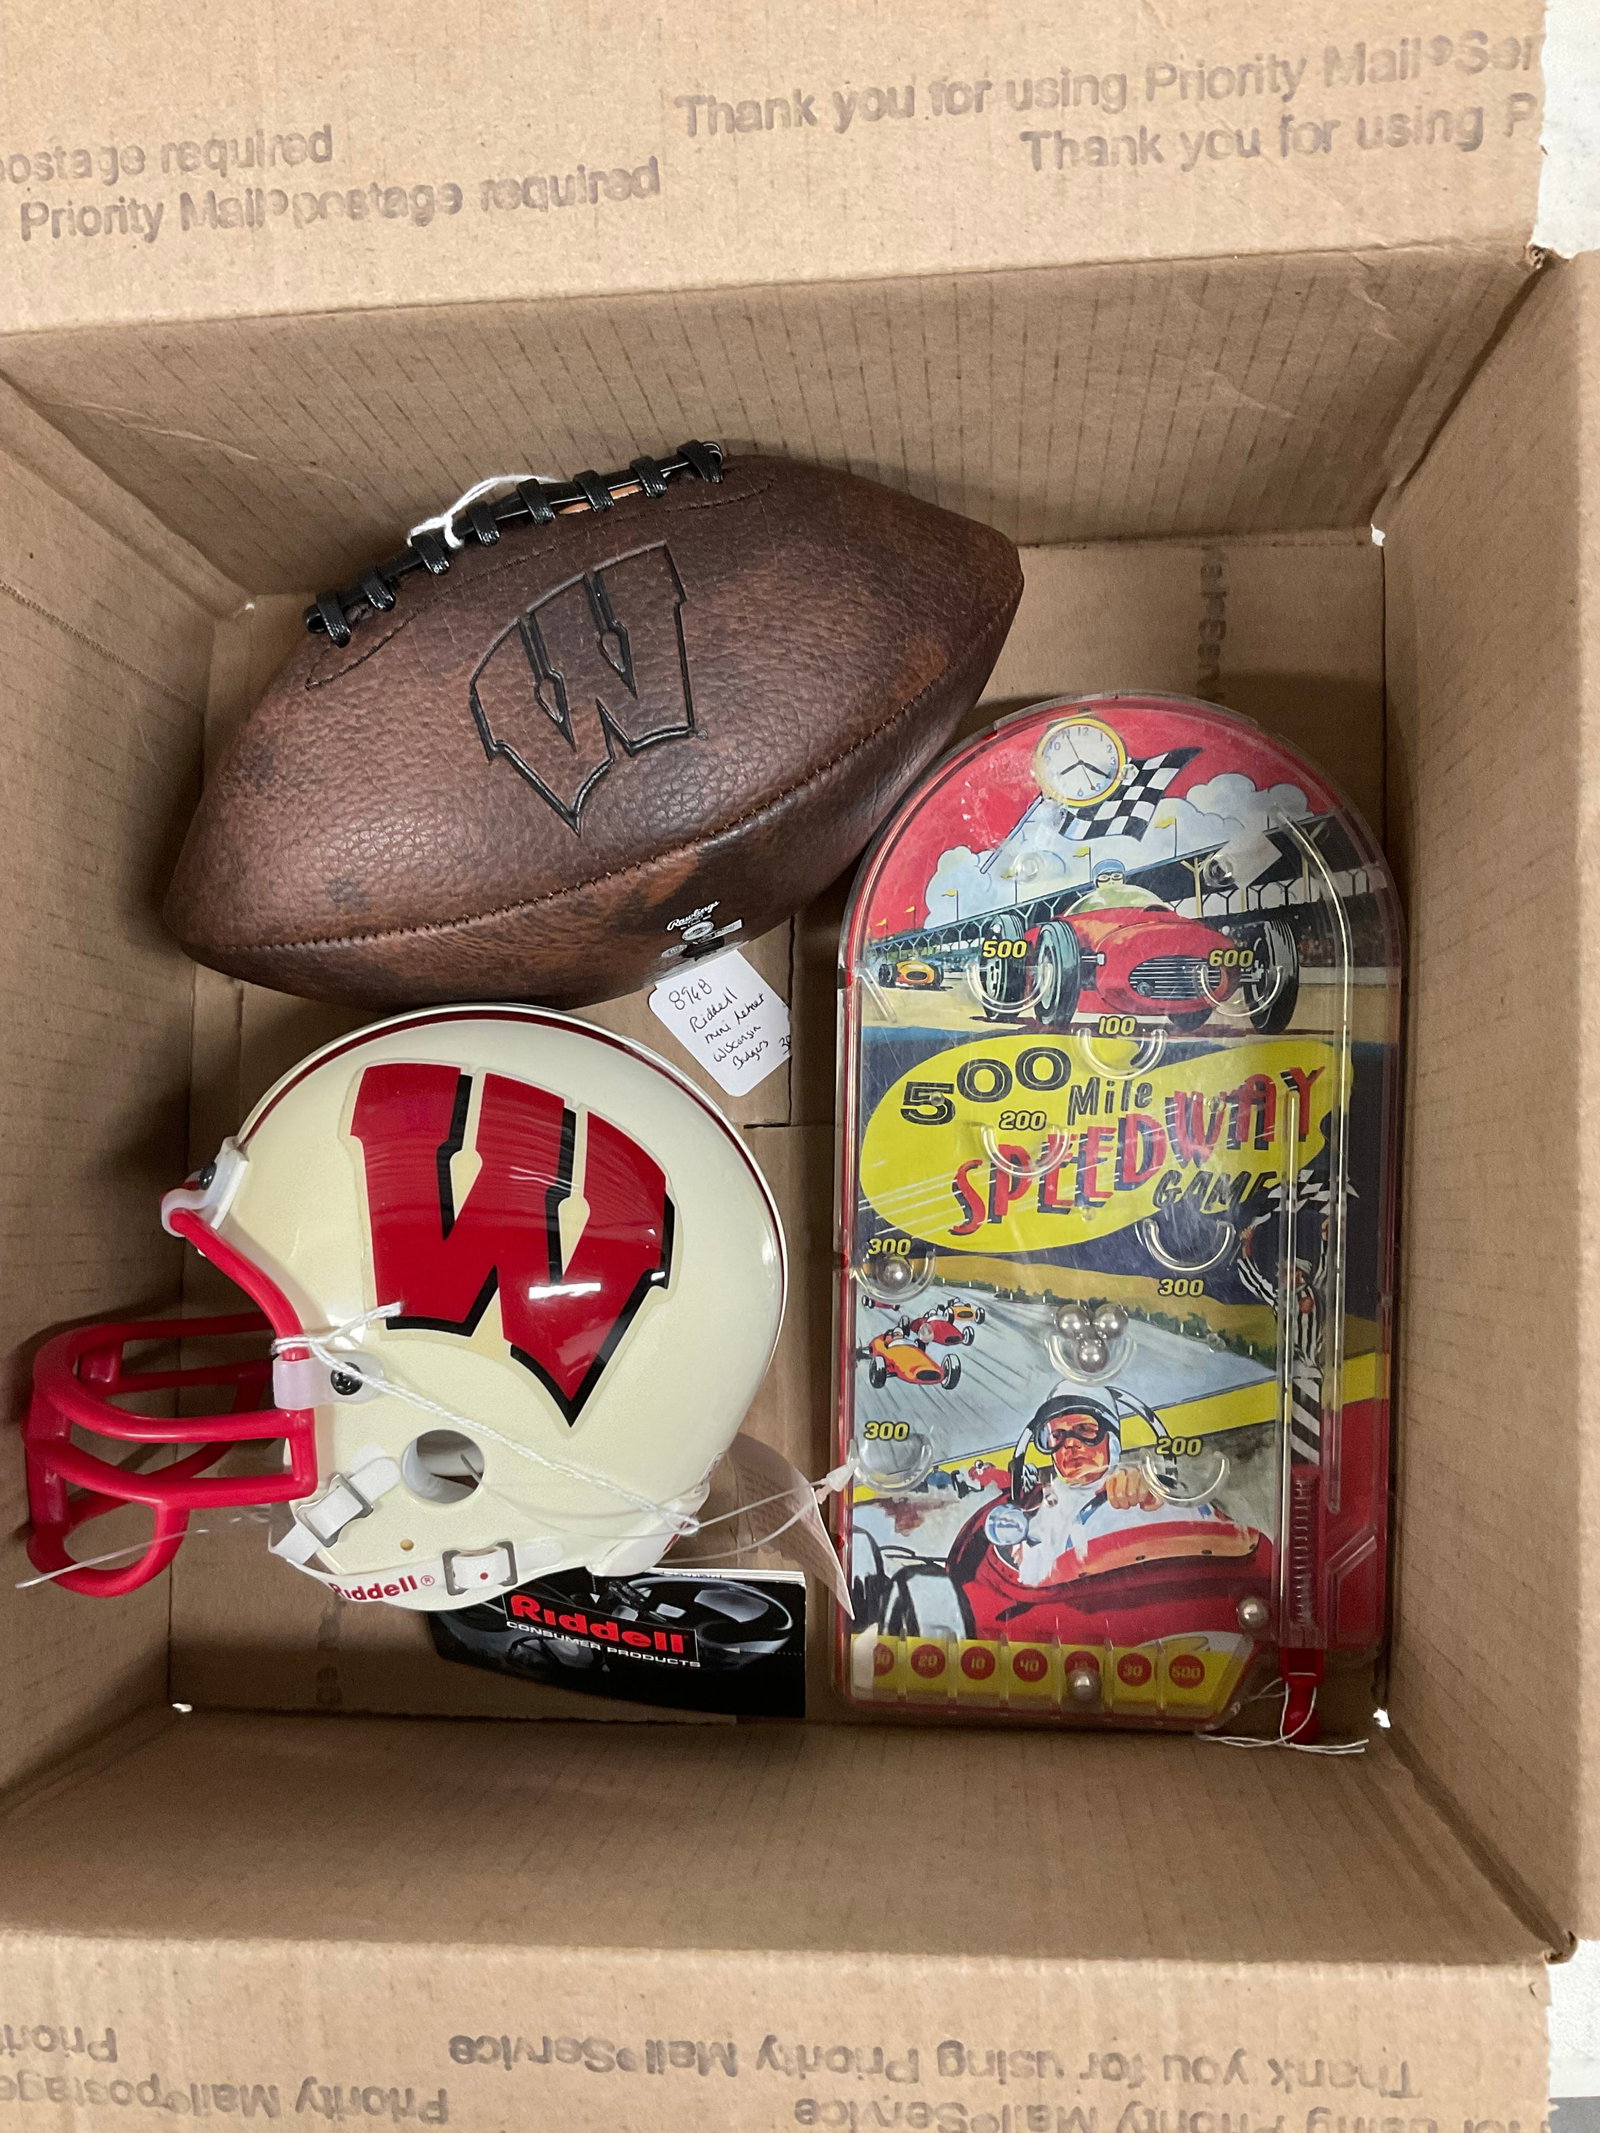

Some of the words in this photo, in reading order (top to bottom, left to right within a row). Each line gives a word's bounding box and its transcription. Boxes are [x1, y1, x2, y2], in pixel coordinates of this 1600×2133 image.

[675, 87, 818, 138] Thank
[832, 85, 915, 134] you
[928, 77, 993, 117] for
[1006, 66, 1128, 115] using
[1145, 53, 1308, 102] Priority
[160, 123, 333, 178] required
[1020, 125, 1165, 171] Thank
[1179, 126, 1261, 172] you
[1280, 113, 1342, 158] for
[1355, 104, 1484, 152] using
[20, 196, 164, 243] Priority
[479, 155, 661, 214] required
[469, 540, 695, 839] W
[666, 900, 720, 931] Rawlings
[982, 939, 1027, 960] 500
[1208, 949, 1254, 969] 600
[689, 987, 738, 1033] Riddell
[1099, 1016, 1135, 1035] 100
[900, 1047, 1071, 1126] 500
[1067, 1076, 1153, 1126] Mile
[998, 1110, 1047, 1130] 200
[350, 1062, 675, 1428] W
[867, 1238, 912, 1257] 300
[1158, 1278, 1205, 1298] 300
[864, 1422, 910, 1441] 300
[1155, 1437, 1203, 1457] 200
[506, 1620, 601, 1651] CONSUMER
[606, 1646, 700, 1668] PRODUCTS
[510, 1594, 684, 1654] Riddell
[918, 1653, 938, 1668] 20
[971, 1658, 985, 1670] 10
[1020, 1659, 1040, 1672] 40
[1123, 1664, 1143, 1678] 30
[1171, 1665, 1201, 1679] 500
[0, 2023, 118, 2064] Priori
[756, 2034, 920, 2084] Priority
[937, 2040, 1065, 2085] using
[1079, 2051, 1145, 2089] for
[1163, 2048, 1248, 2087] you
[1267, 2057, 1423, 2098] Thank
[295, 2075, 449, 2125] Priority
